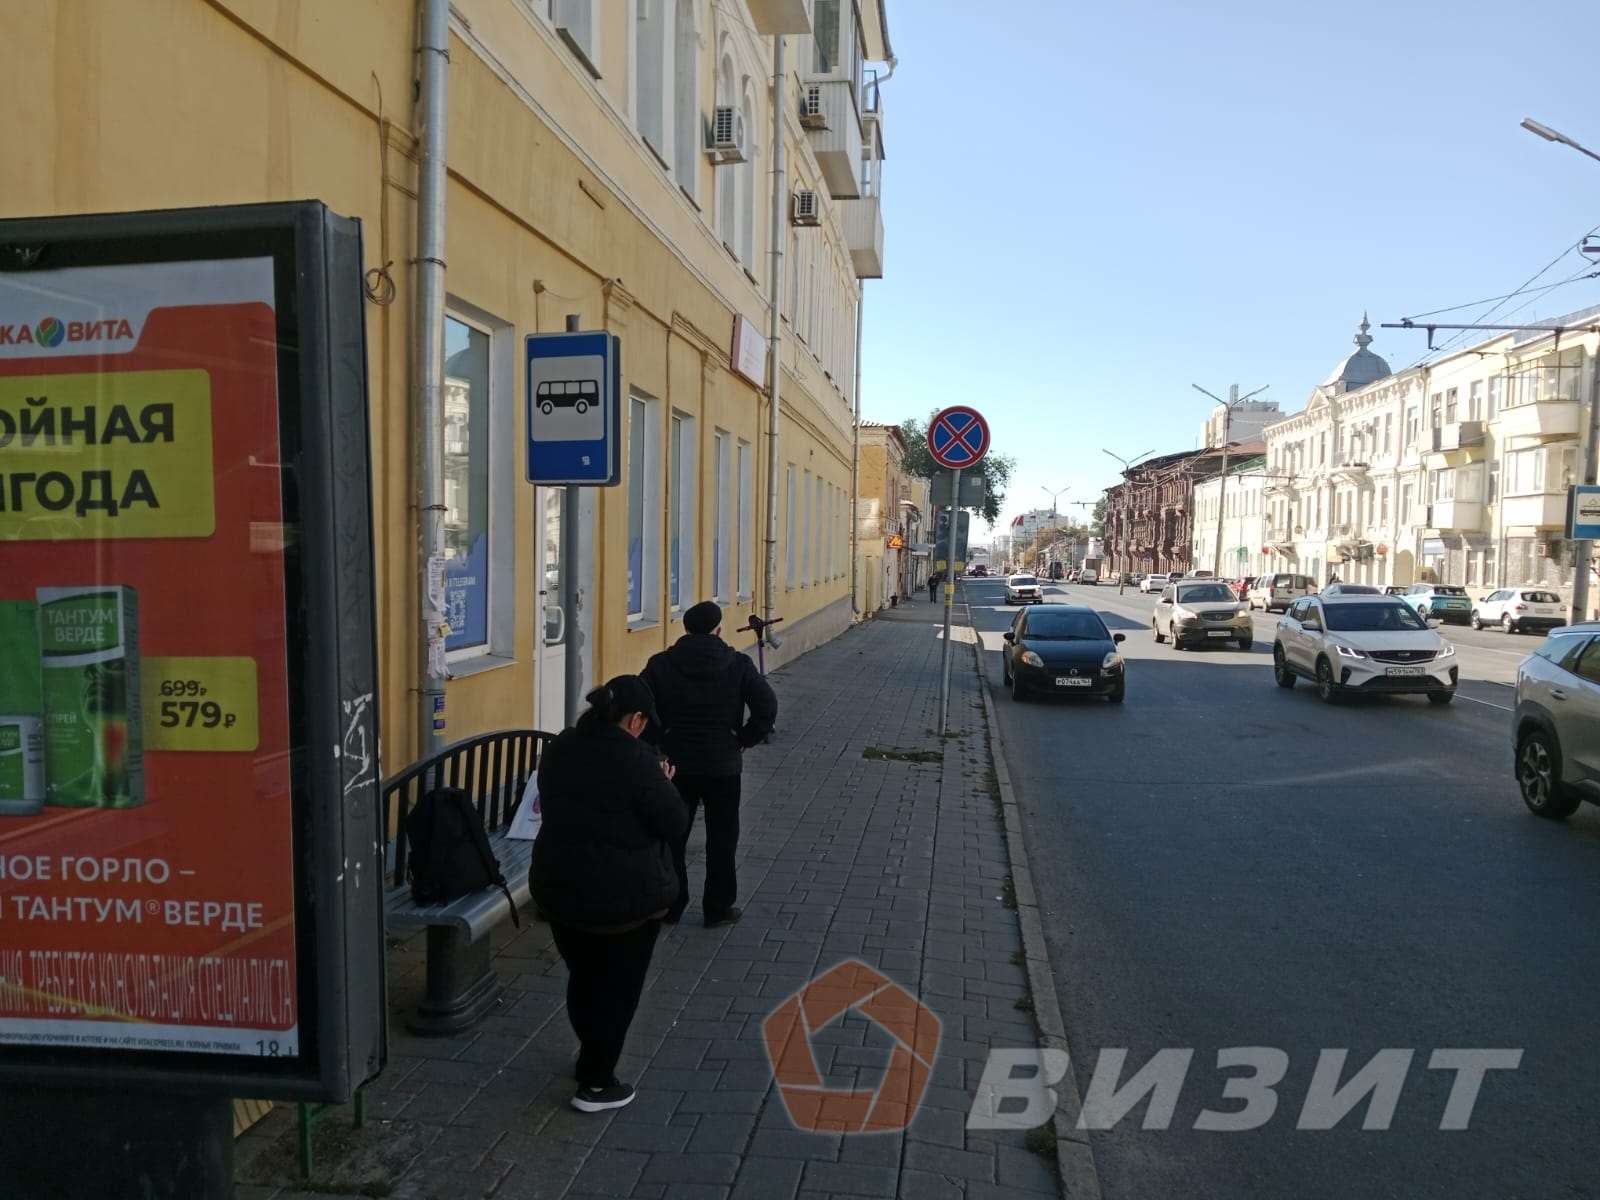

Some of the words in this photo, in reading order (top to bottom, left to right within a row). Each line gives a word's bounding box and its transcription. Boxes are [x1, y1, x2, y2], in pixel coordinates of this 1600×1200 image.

[67, 319, 135, 342] ВИТА
[0, 469, 160, 518] ГОДА
[47, 608, 113, 625] ТАНТУМ
[55, 626, 105, 645] ВЕРДЕ
[159, 701, 236, 729] 579₽
[60, 856, 170, 884] ГОРЛО
[164, 900, 265, 932] ВЕРДЕ
[30, 950, 98, 1014] ТРЕБУЕТСЯ
[99, 952, 195, 1022] КОНСУЛЬТАЦИЯ
[198, 954, 294, 1025] СПЕЦИАЛИСТА
